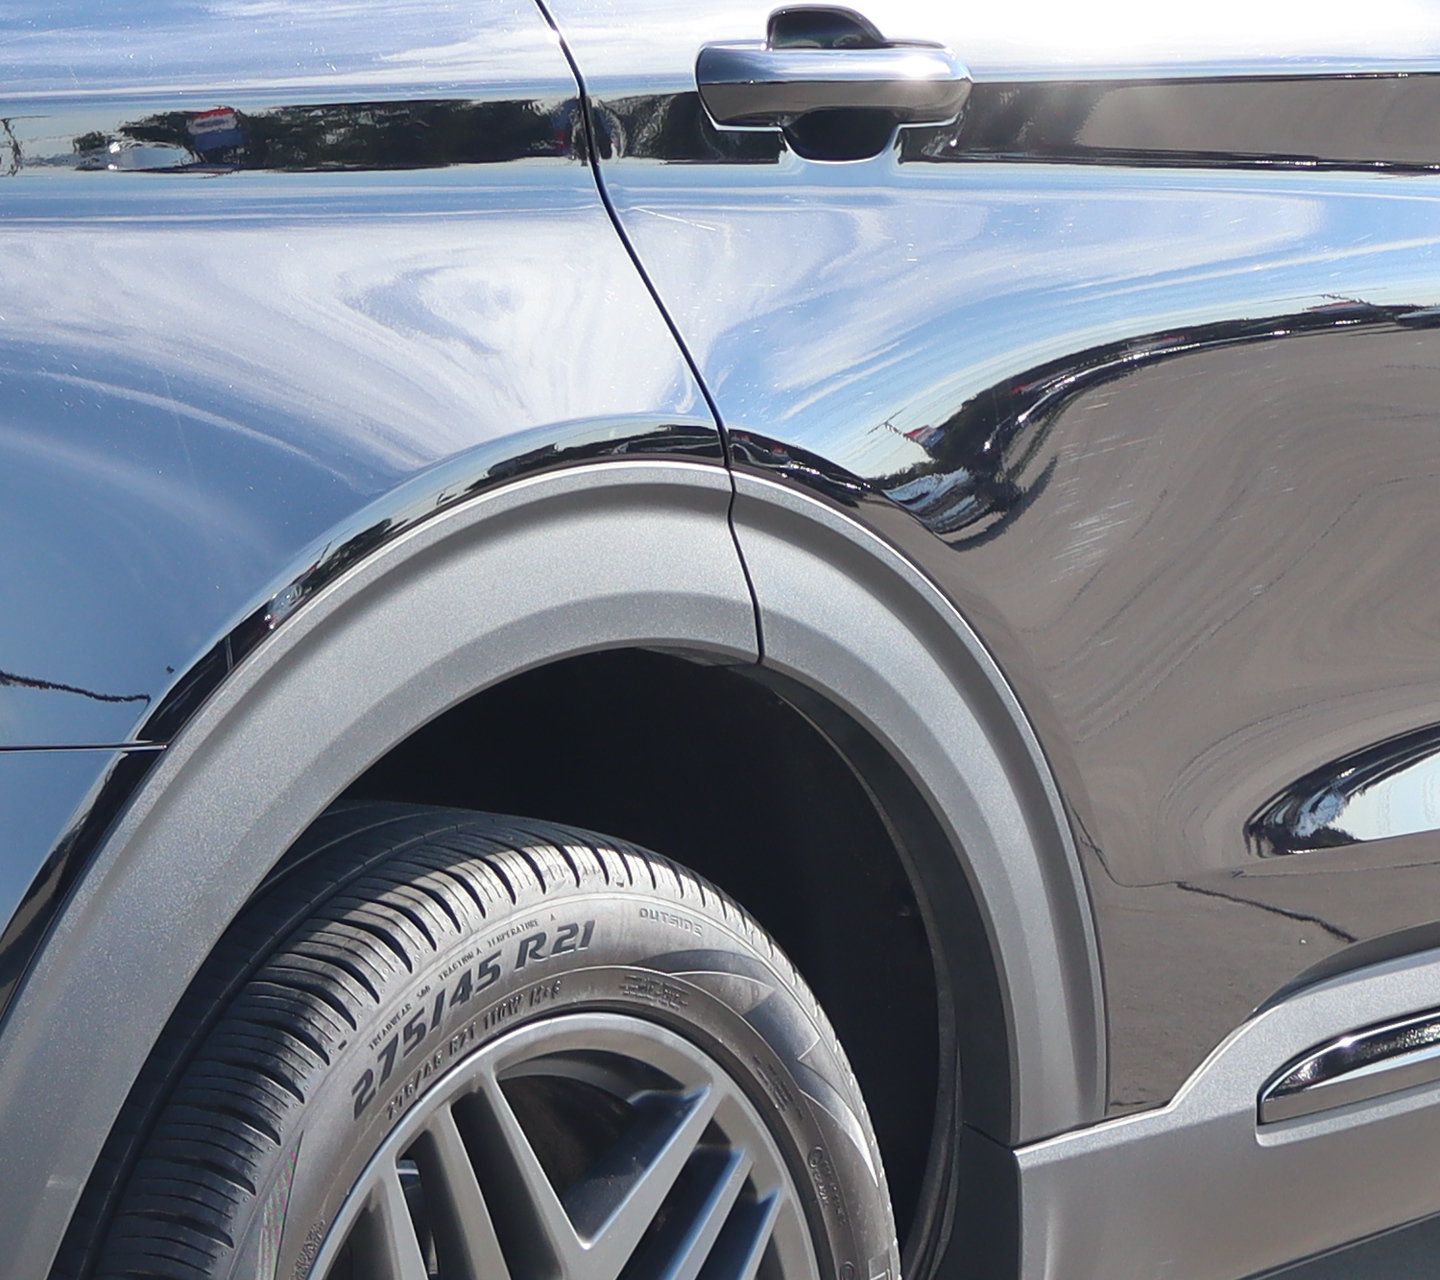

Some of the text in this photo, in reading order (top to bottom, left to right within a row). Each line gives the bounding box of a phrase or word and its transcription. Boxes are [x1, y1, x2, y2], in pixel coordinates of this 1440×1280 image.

[438, 949, 475, 982] TRACTION
[487, 918, 539, 948] TEMPERATURE
[639, 907, 704, 937] OUTSIDE
[351, 919, 596, 1121] 275/45 R21
